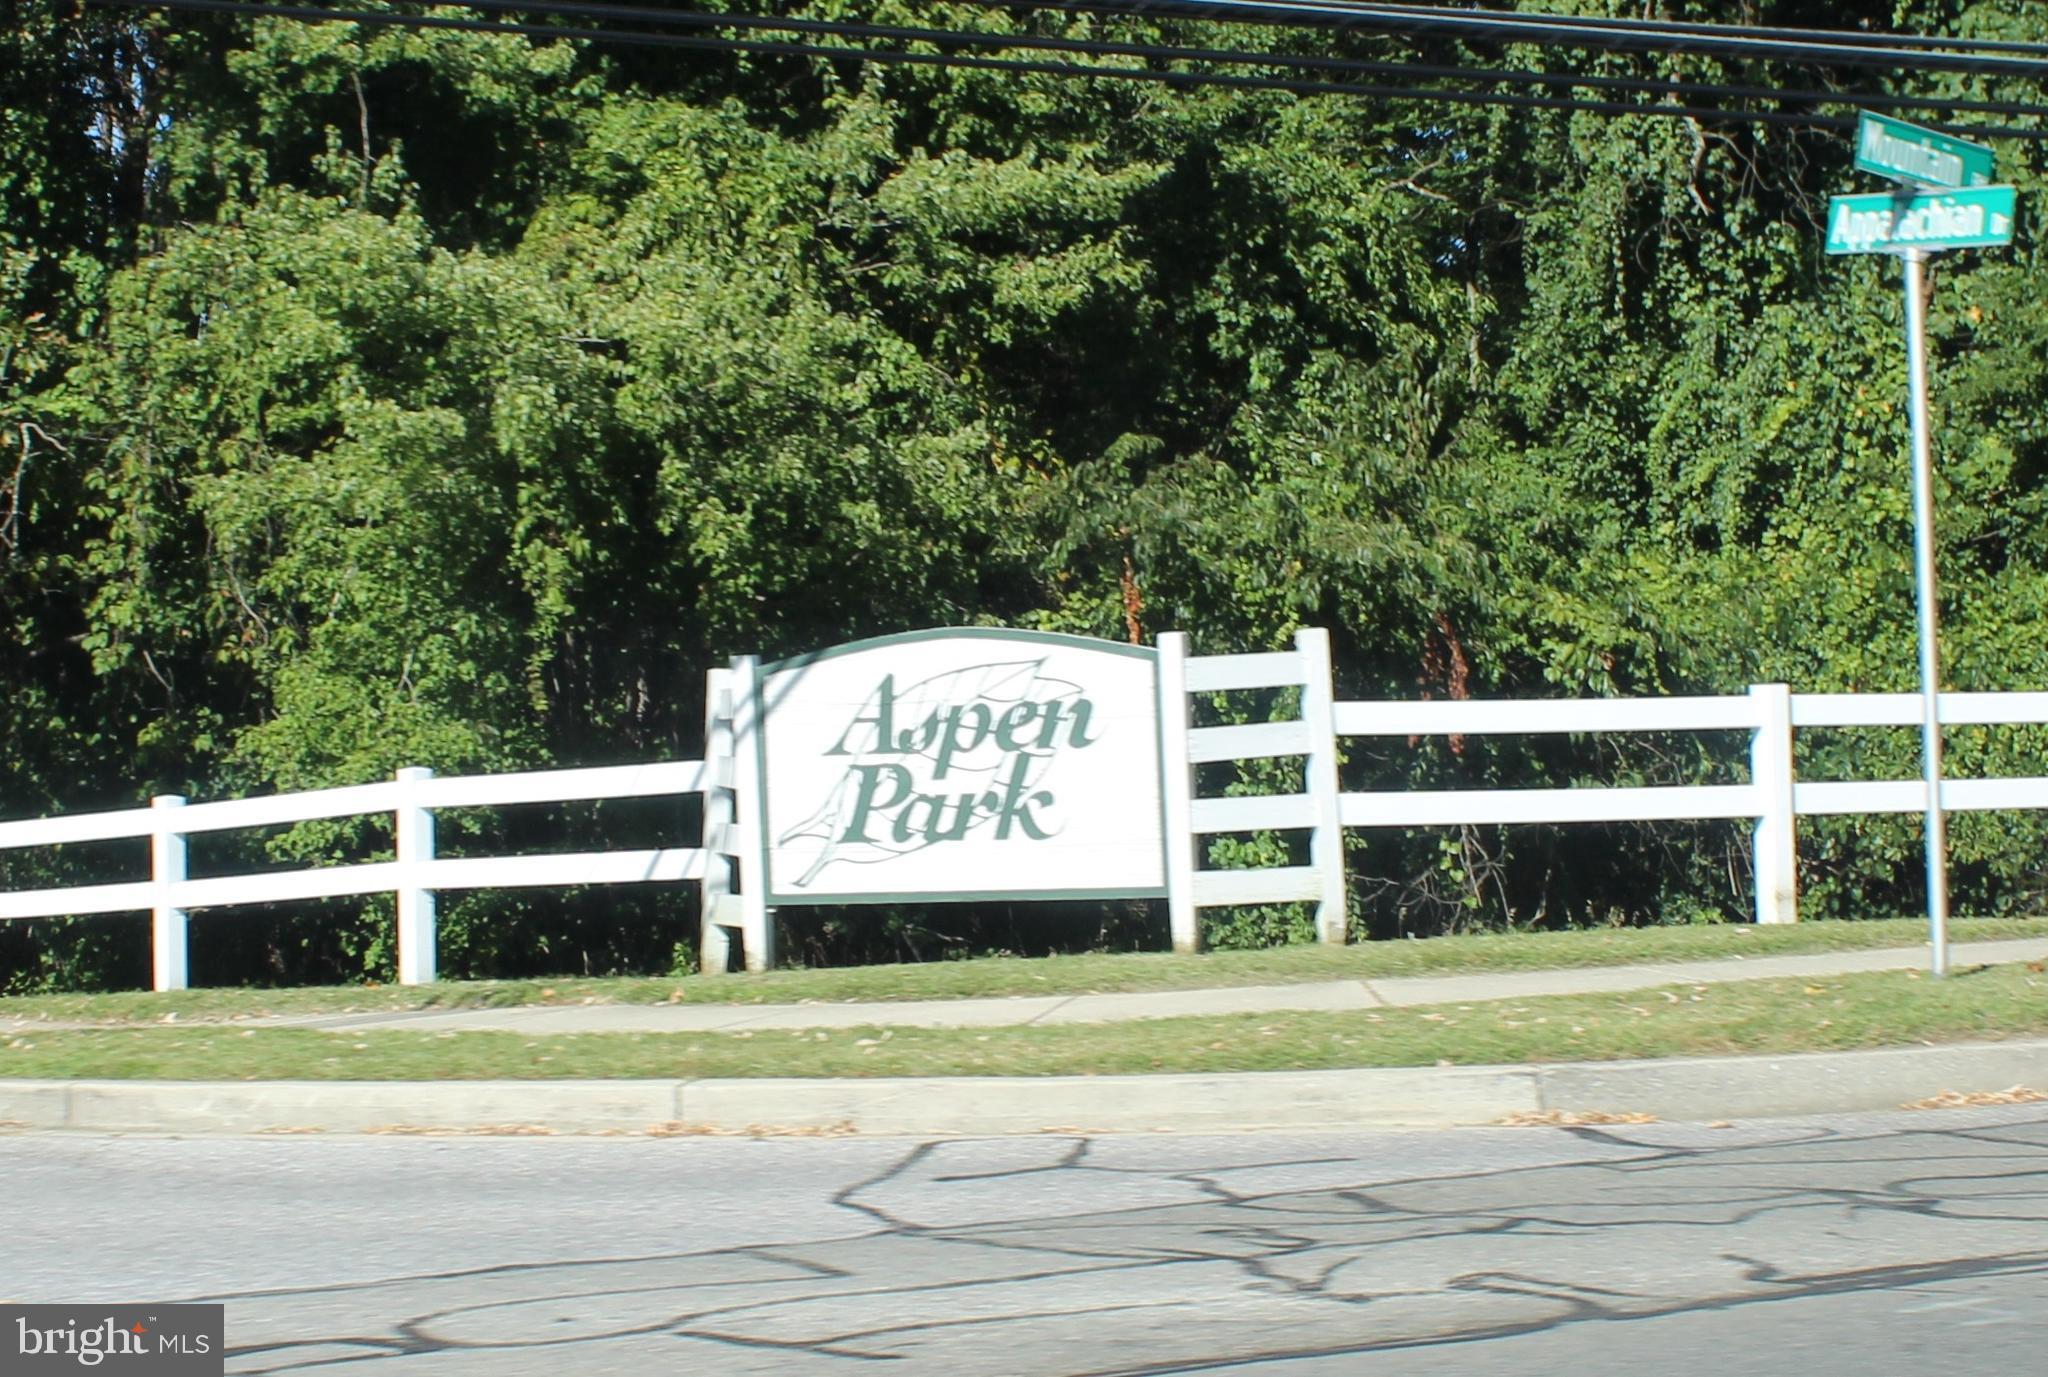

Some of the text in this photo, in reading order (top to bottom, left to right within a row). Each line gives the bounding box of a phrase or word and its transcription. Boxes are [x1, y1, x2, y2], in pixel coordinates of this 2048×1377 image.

[1831, 197, 1984, 250] Appaachian
[822, 674, 1099, 779] Aspen
[835, 752, 1064, 843] Park
